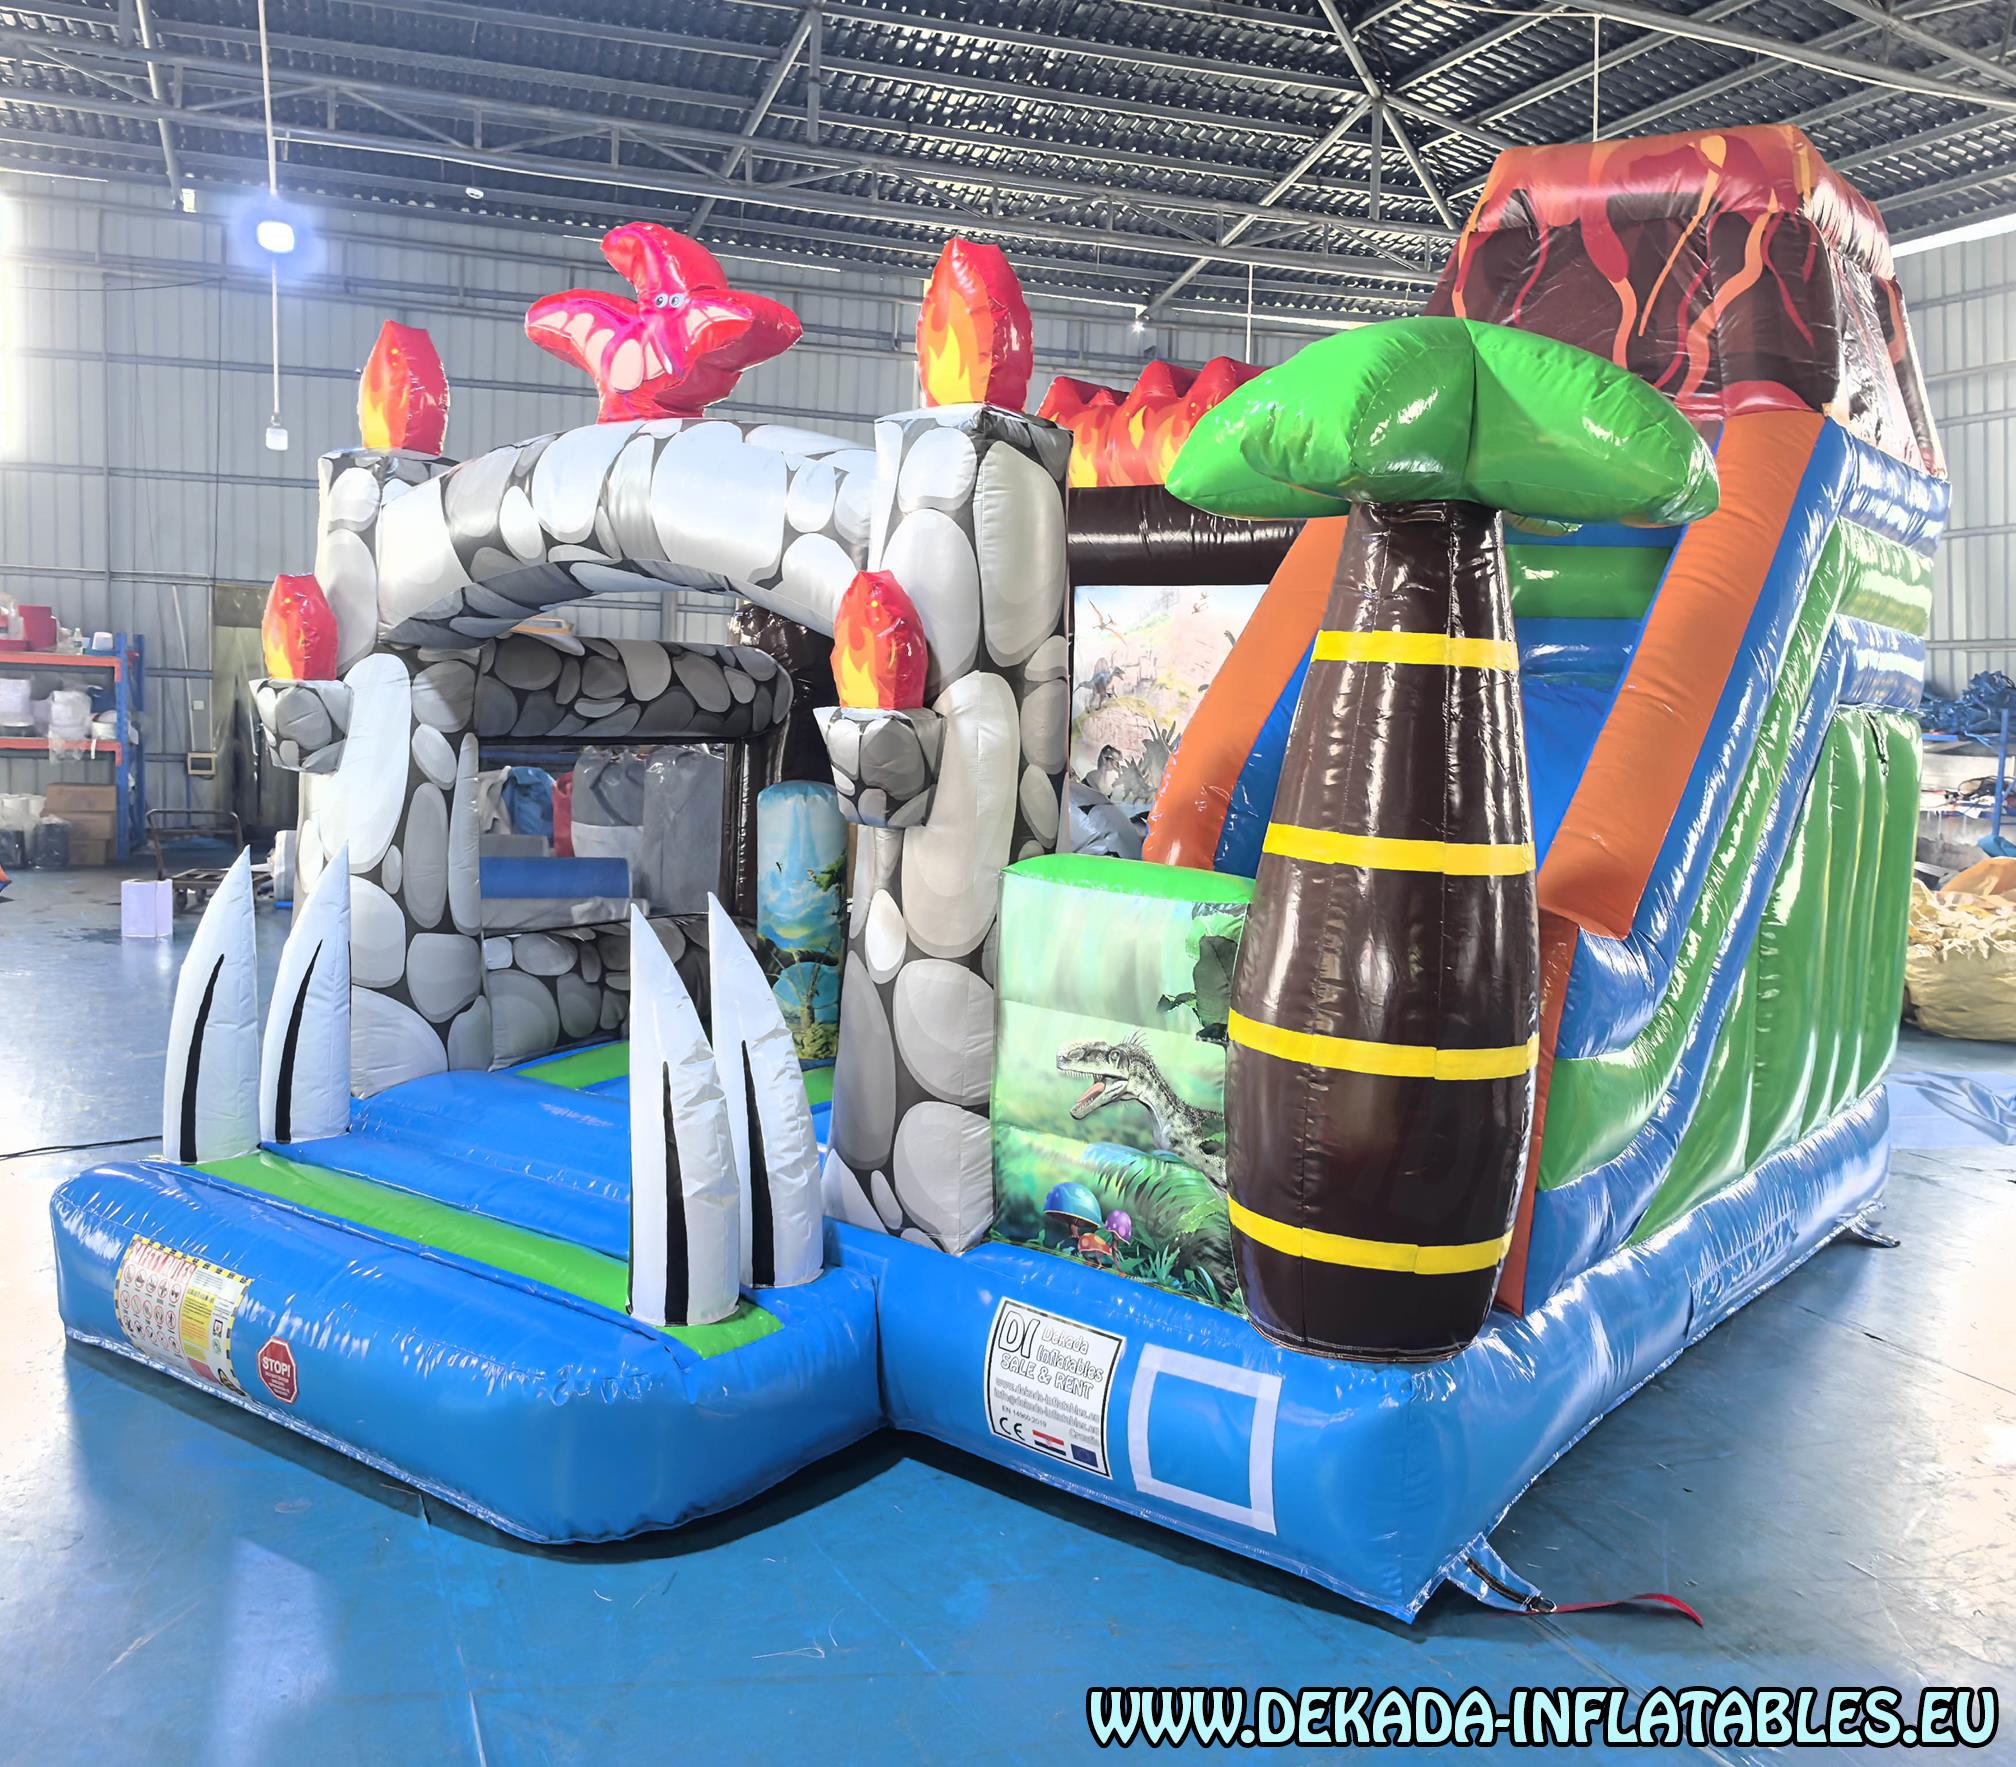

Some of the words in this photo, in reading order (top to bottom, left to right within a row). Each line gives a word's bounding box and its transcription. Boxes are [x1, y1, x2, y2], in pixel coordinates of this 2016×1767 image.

[1042, 1325, 1090, 1355] Dekada
[262, 1356, 291, 1378] STOP!
[1001, 1353, 1037, 1380] SALE
[1038, 1366, 1052, 1385] &
[1054, 1371, 1095, 1399] RENT
[1036, 1344, 1104, 1382] Inflatables
[999, 1417, 1025, 1441] CE
